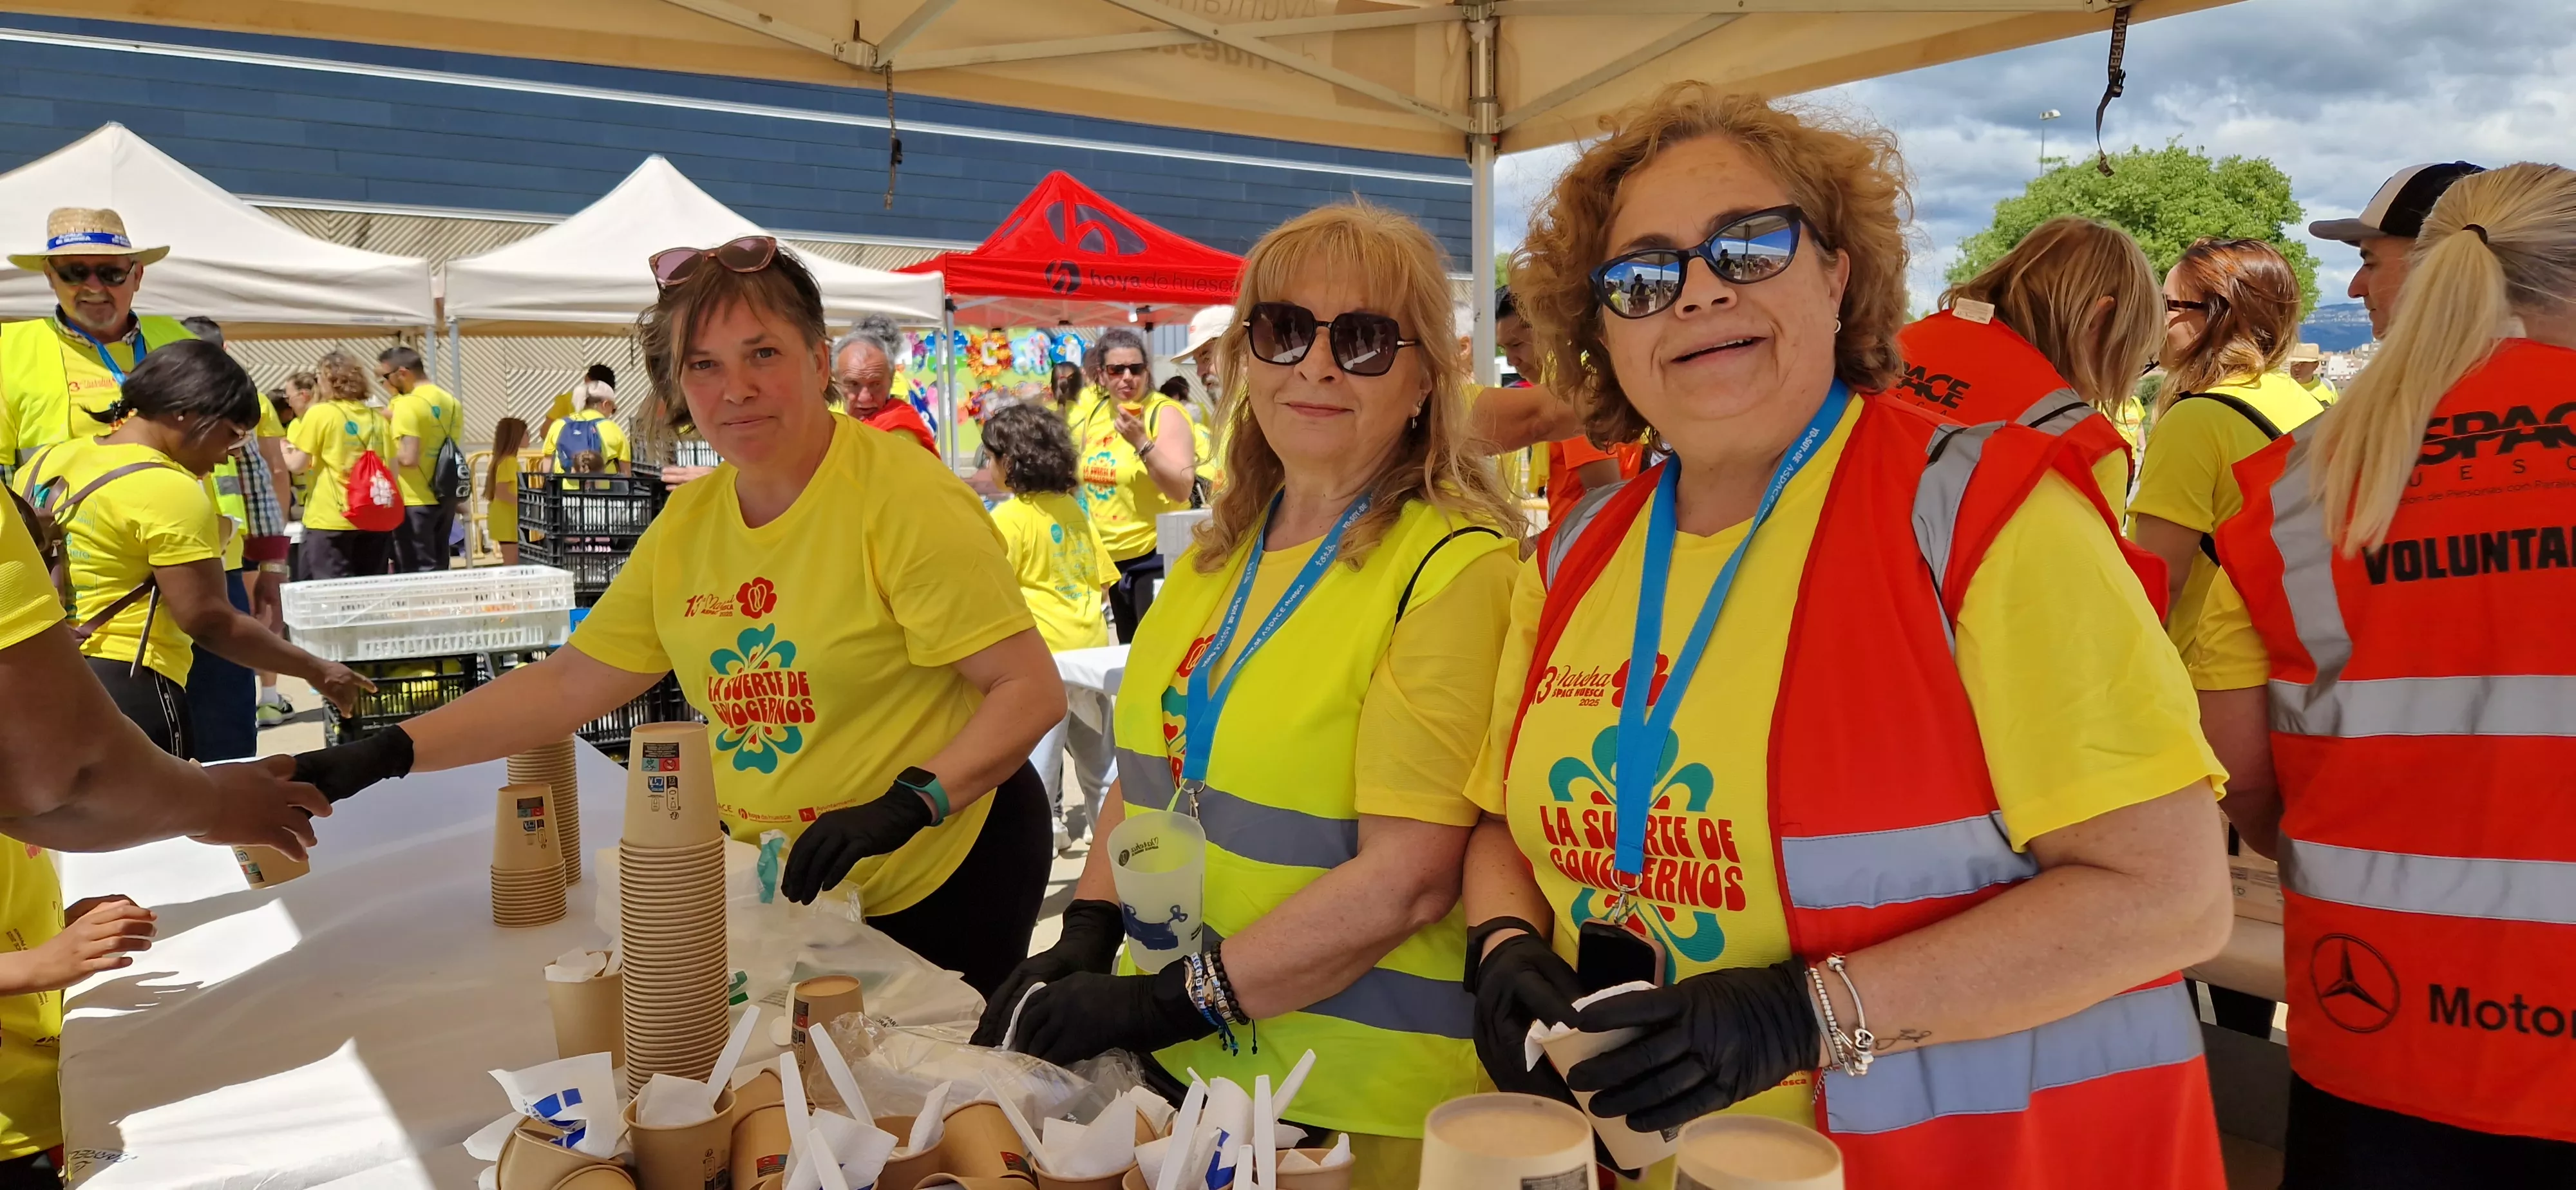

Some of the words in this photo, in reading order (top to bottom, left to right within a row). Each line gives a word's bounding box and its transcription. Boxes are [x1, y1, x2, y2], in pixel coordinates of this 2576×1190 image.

[1090, 269, 1141, 291] hoya
[1144, 271, 1168, 289] de
[2416, 401, 2576, 467] SPAC
[2361, 525, 2576, 585] VOLUNTA
[708, 676, 725, 702] LA
[723, 671, 785, 701] SUERTE
[787, 671, 811, 698] DE
[1551, 688, 1574, 698] SPACE
[1574, 688, 1604, 697] HUESCA
[1578, 698, 1600, 706] 2025
[1540, 805, 1581, 847] LA
[1582, 809, 1696, 858] SURTE
[1698, 817, 1741, 864] DE
[1776, 1079, 1807, 1087] esca
